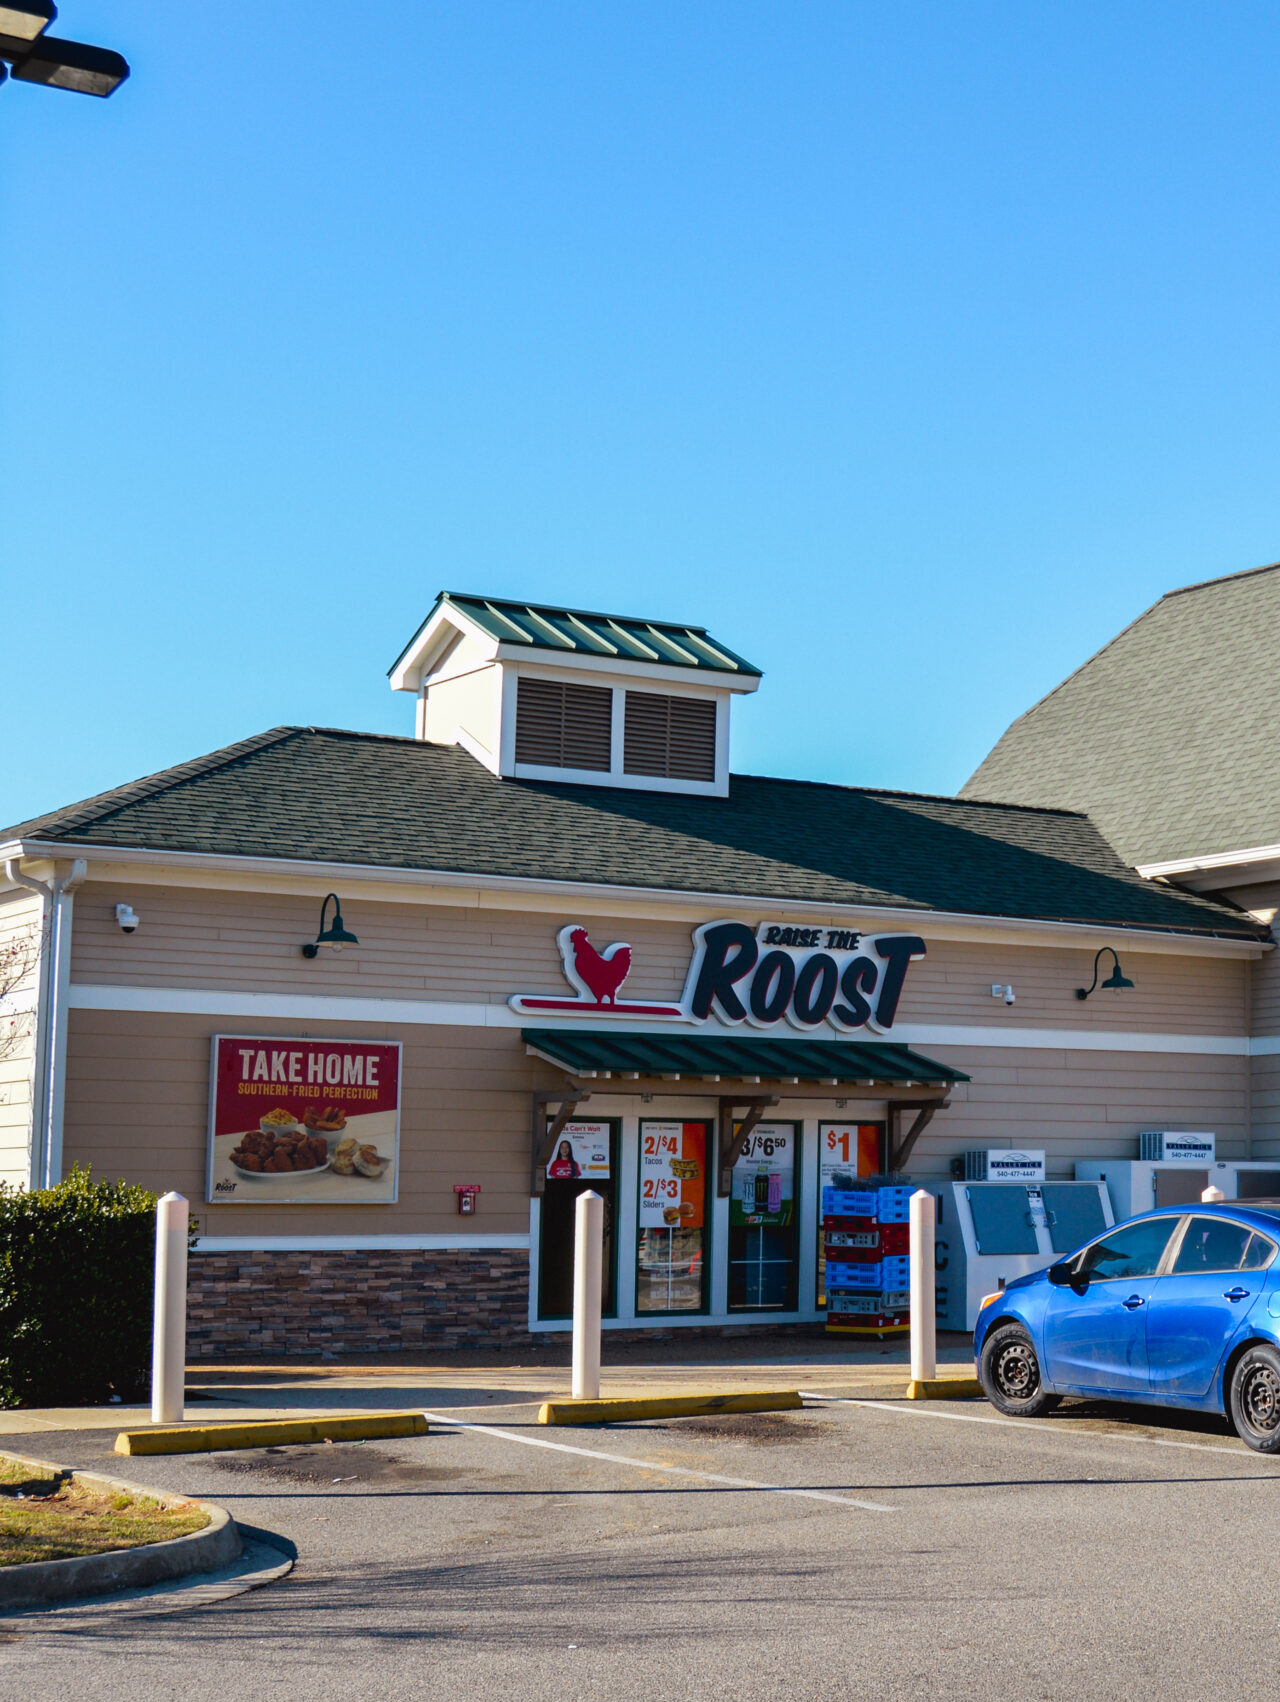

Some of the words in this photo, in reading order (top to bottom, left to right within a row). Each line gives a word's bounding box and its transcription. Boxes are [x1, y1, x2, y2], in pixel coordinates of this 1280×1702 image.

[762, 926, 822, 948] RAISE
[825, 930, 861, 950] THE
[691, 922, 927, 1029] ROOST
[238, 1049, 303, 1082] TAKE
[307, 1053, 380, 1085] HOME
[238, 1083, 320, 1098] SOUTHERN-FRIED
[323, 1086, 378, 1100] PERFECTION
[644, 1135, 679, 1156] 2/$4
[827, 1130, 849, 1162] $1
[644, 1157, 663, 1165] Tacos
[643, 1179, 679, 1199] 2/$3
[642, 1200, 665, 1209] Sliders
